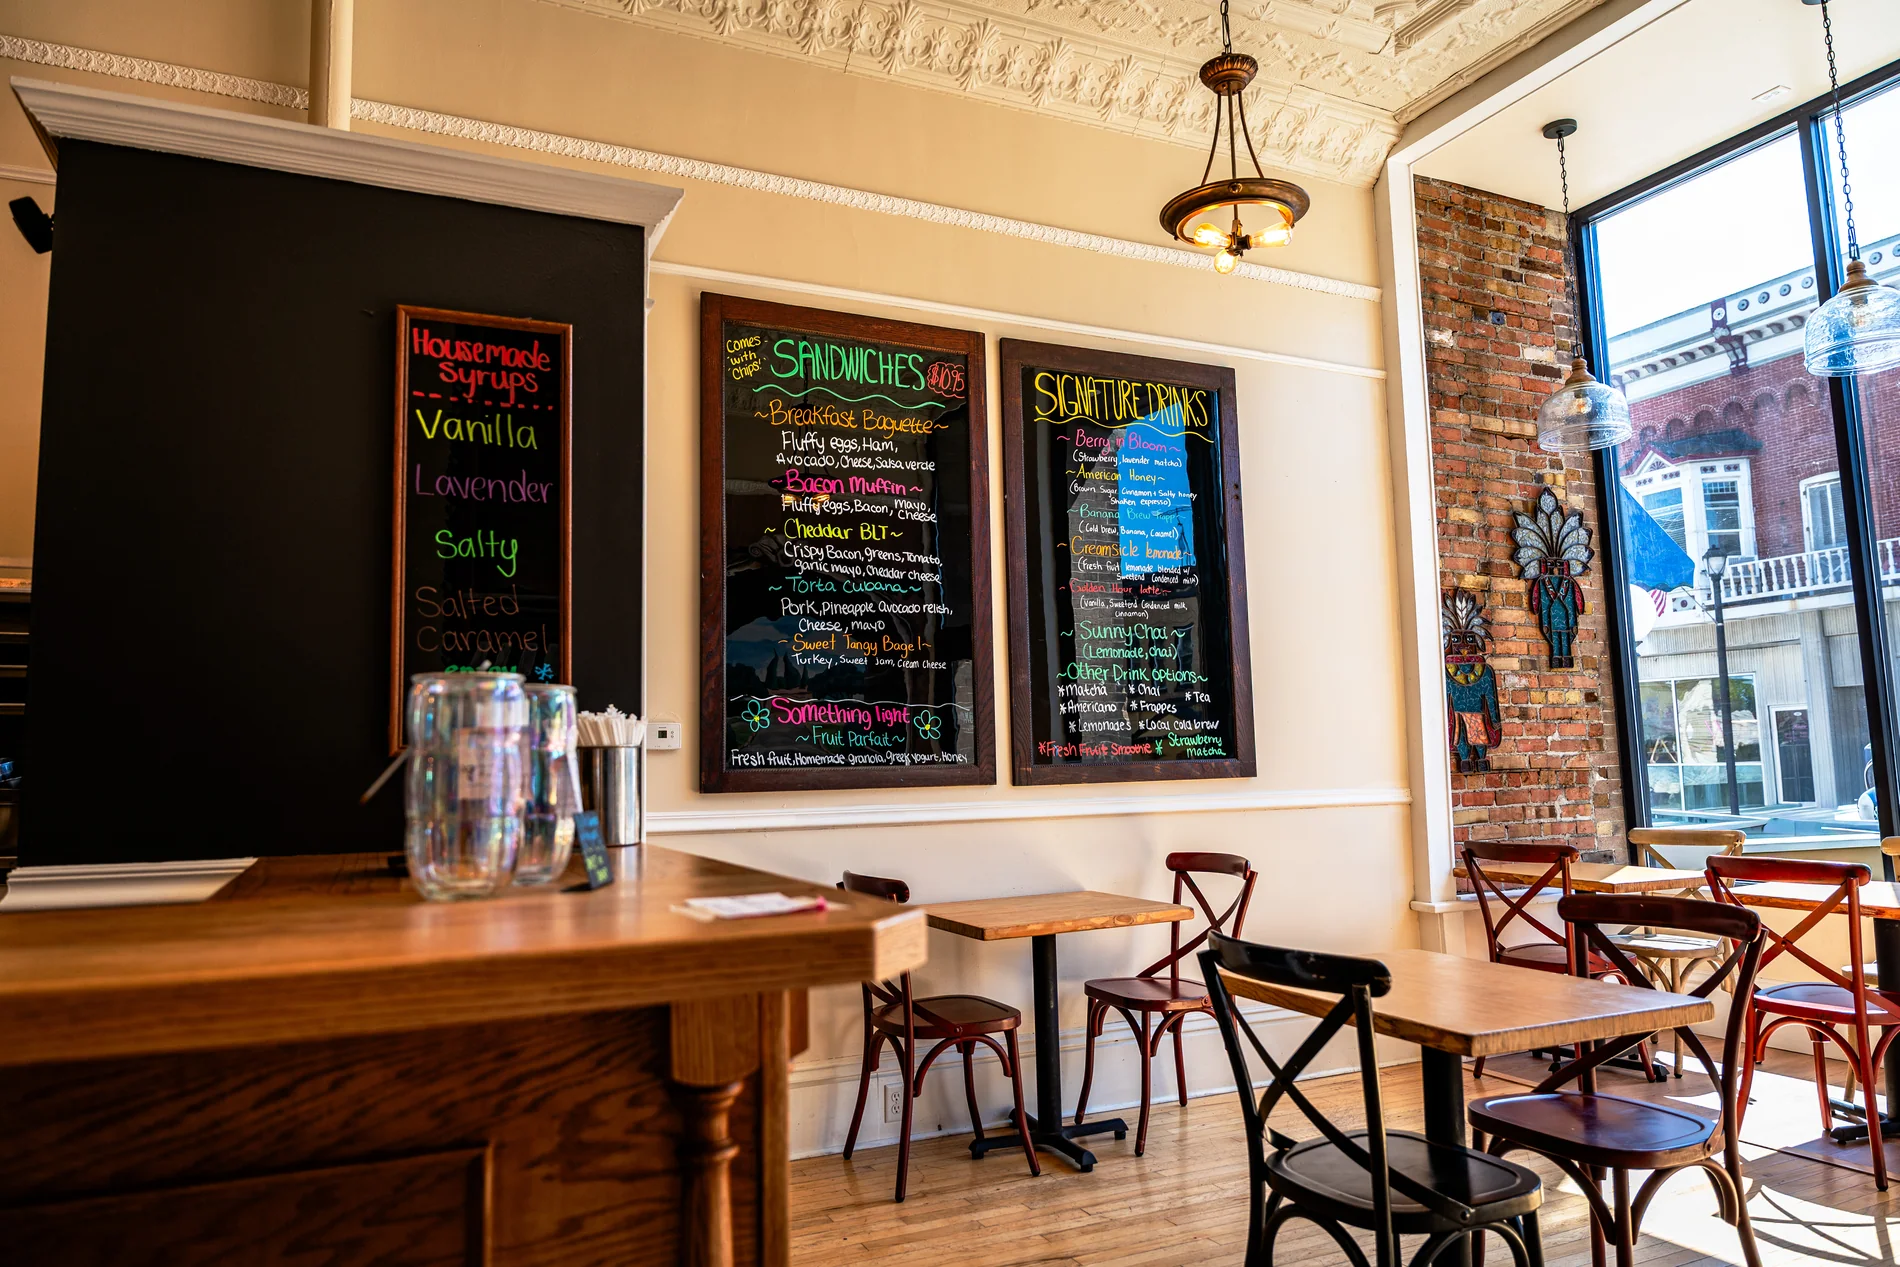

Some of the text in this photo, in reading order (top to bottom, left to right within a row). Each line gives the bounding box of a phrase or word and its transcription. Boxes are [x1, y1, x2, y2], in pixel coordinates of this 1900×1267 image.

[413, 328, 551, 371] Housemade
[726, 336, 761, 353] Comes
[730, 351, 757, 365] with
[770, 339, 925, 391] SANDWICHES
[732, 359, 762, 380] Chips!
[1034, 372, 1208, 427] SIGNATURE DRINKS
[416, 409, 538, 449] Vanilla
[770, 399, 933, 439] Breakfast Baguette
[782, 431, 898, 453] Fluffy eggs, Ham,
[1075, 429, 1166, 455] Berry in Bloom
[776, 453, 839, 469] Avocado,
[905, 459, 935, 471] verde
[1122, 454, 1149, 465] lavender
[415, 464, 553, 503] Lavender
[786, 469, 844, 494] Bacon
[1075, 464, 1156, 485] American Honey
[782, 494, 821, 515] Fluffy
[821, 500, 855, 514] eggs,
[854, 499, 893, 516] Bacon,
[1178, 491, 1197, 500] honey
[1079, 503, 1120, 519] Banana
[1126, 508, 1150, 519] Brew
[784, 518, 888, 540] Cheddar BLT
[435, 529, 518, 577] Salty
[784, 541, 824, 562] Crispy
[826, 545, 864, 562] Bacon,
[902, 552, 942, 567] Tomato,
[1071, 535, 1184, 560] Creamsicle lemonade
[794, 559, 829, 574] garlic
[831, 563, 865, 577] mayo,
[908, 571, 942, 584] cheese
[1125, 562, 1153, 572] lemonade
[1158, 562, 1181, 574] blended
[785, 576, 908, 593] Torta Cubana
[1069, 578, 1162, 595] Golden Hour latte
[416, 584, 520, 619] Salted
[781, 597, 822, 617] Pork,
[923, 602, 953, 615] relish,
[799, 618, 848, 633] Cheese,
[1079, 620, 1168, 646] Sunny Chai
[417, 624, 548, 653] Caramel
[792, 633, 836, 652] Sweet
[842, 634, 877, 657] Tangy
[792, 653, 837, 669] Turkey,
[1066, 662, 1110, 681] Other
[1113, 663, 1150, 682] Drink
[1138, 684, 1160, 697] Chai
[1193, 691, 1211, 703] Tea
[772, 697, 910, 730] Something light
[1067, 700, 1177, 714] Americano Frappes
[1078, 718, 1132, 732] Lemonades
[1145, 719, 1169, 731] Local
[1193, 719, 1220, 730] brew
[812, 725, 892, 747] Fruit Parfait
[1168, 731, 1222, 749] Strawberry
[731, 748, 765, 767] Fresh
[766, 750, 795, 766] fruit,
[795, 752, 844, 765] Homemade
[1046, 740, 1152, 758] Fresh Fruit Smoothie
